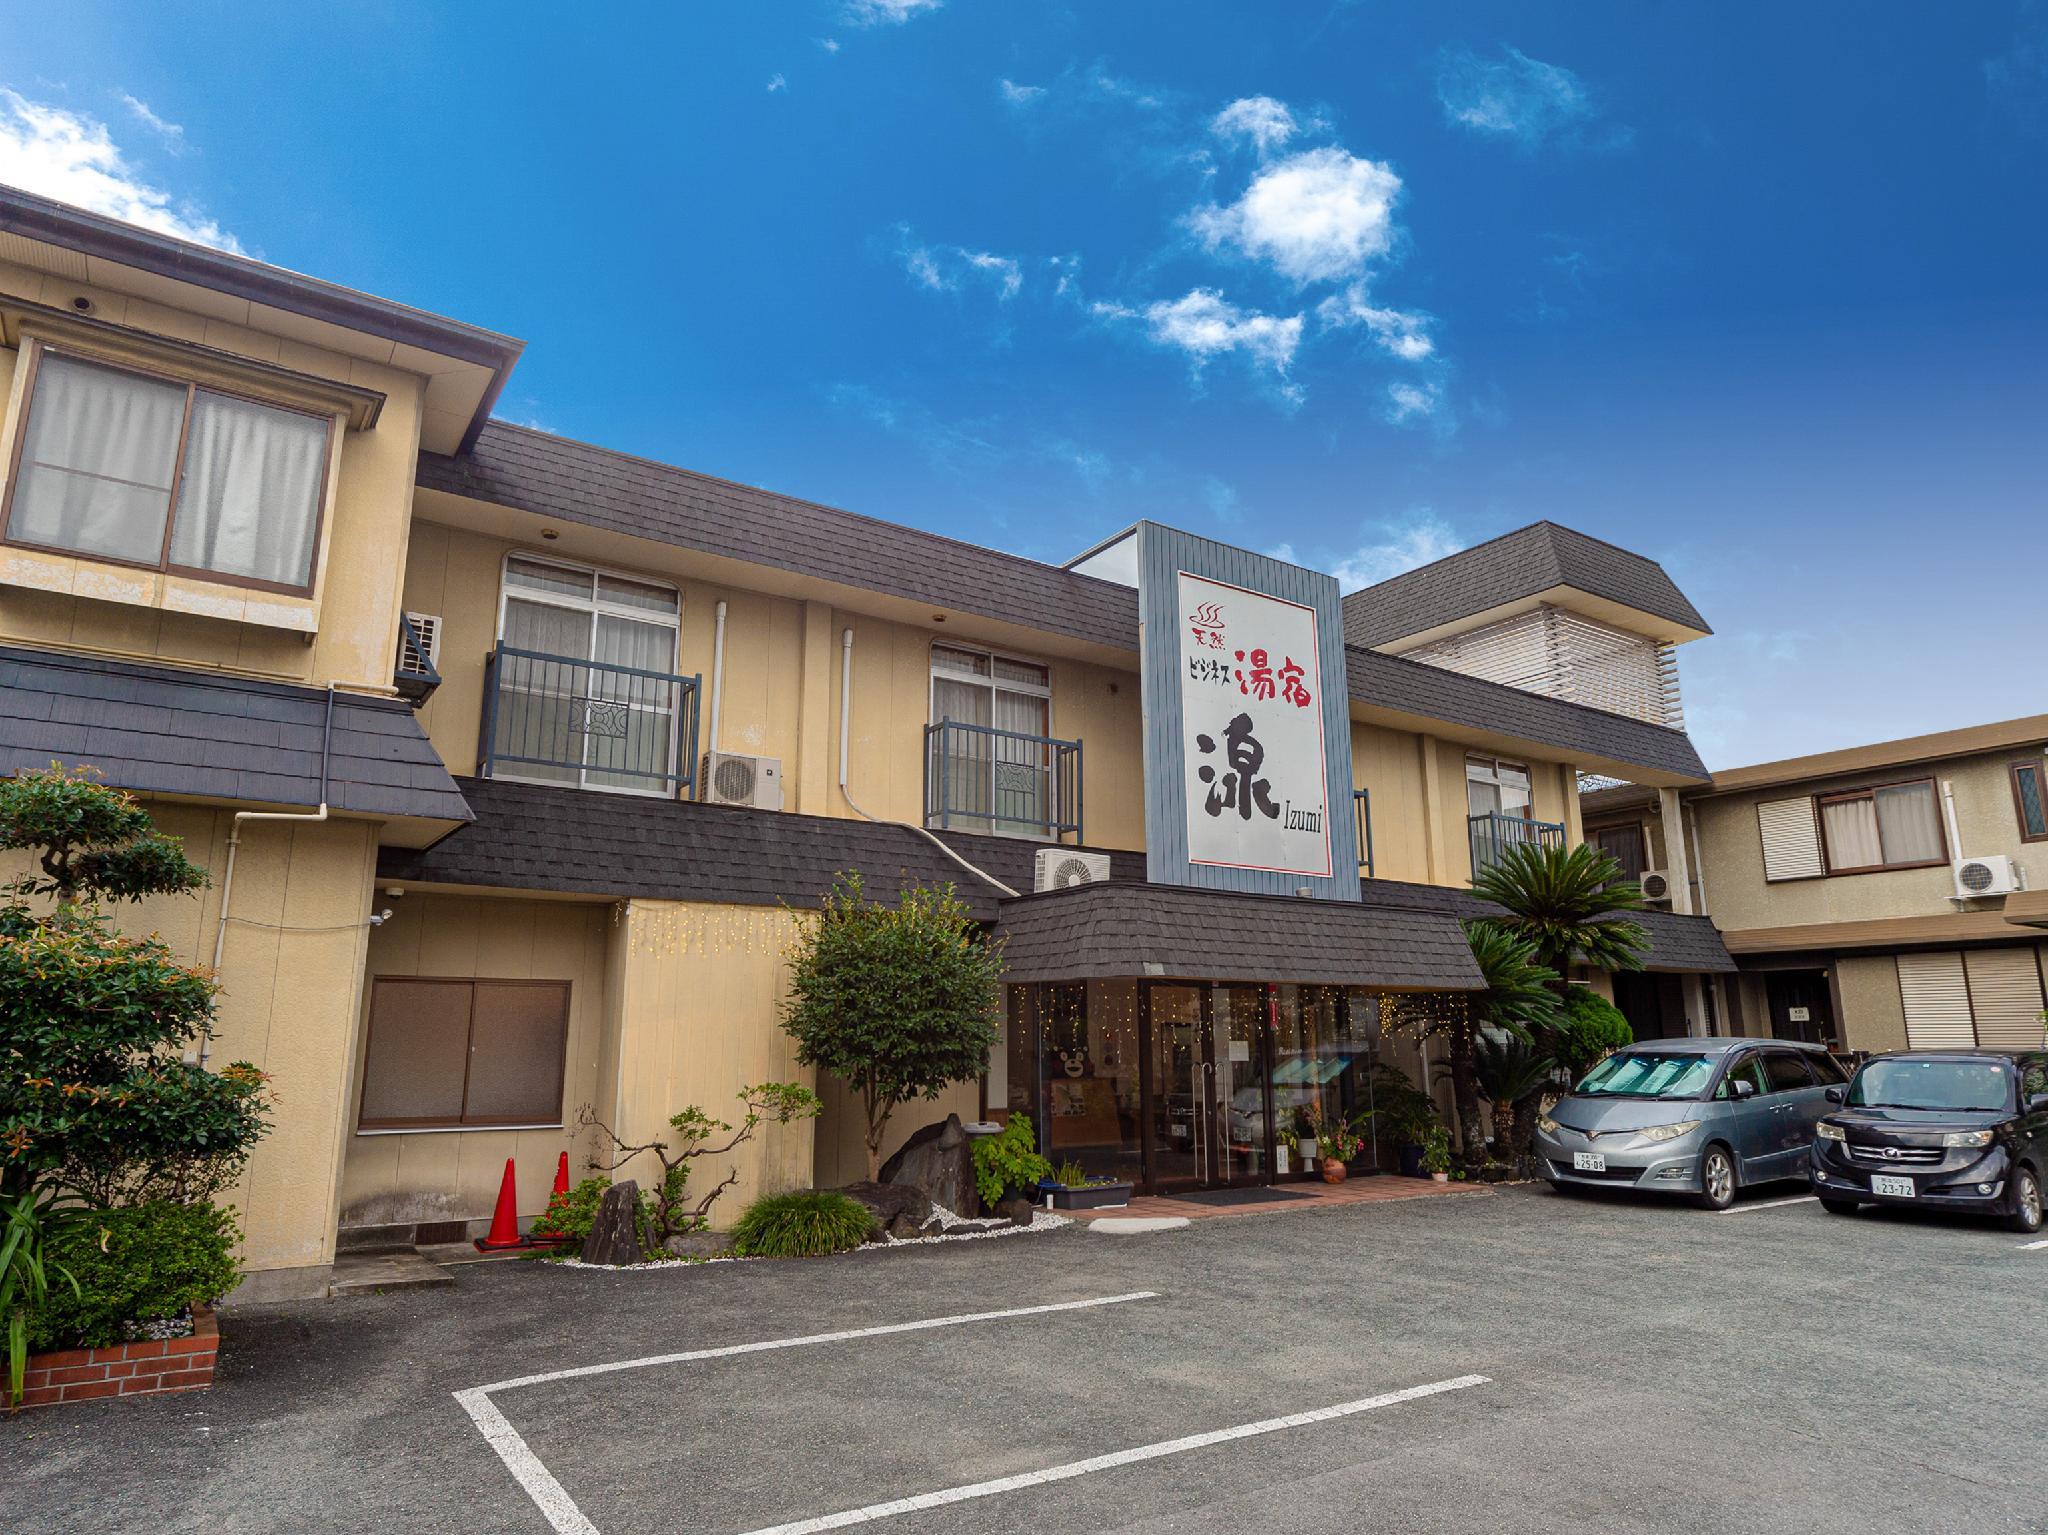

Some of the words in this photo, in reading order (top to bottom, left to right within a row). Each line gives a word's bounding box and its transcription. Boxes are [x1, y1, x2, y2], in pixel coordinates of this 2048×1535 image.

[1192, 628, 1225, 650] 天然
[1283, 800, 1321, 833] Izumi
[1882, 1183, 1912, 1195] 23-72
